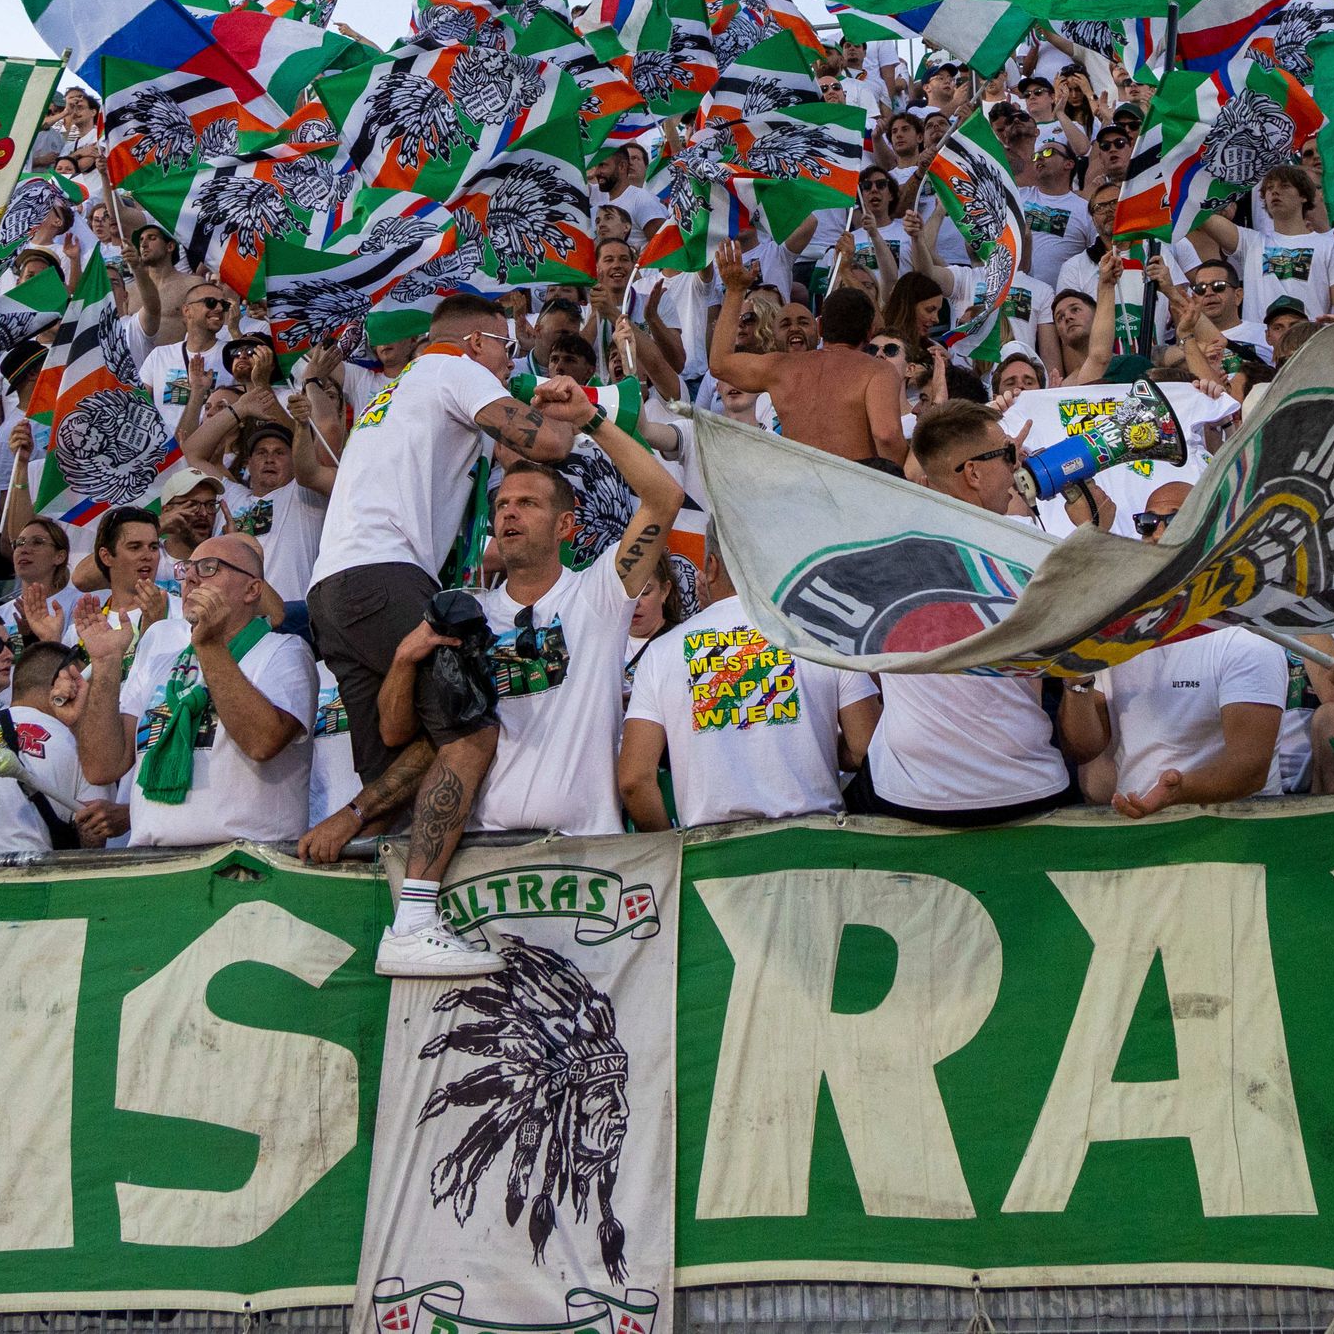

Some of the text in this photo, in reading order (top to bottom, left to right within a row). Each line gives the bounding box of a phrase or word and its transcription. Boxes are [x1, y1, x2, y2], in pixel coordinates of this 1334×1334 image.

[1062, 401, 1124, 417] VENE
[687, 629, 764, 650] VENEZ
[689, 649, 793, 676] MESTRE
[692, 675, 794, 701] RAPID
[694, 701, 797, 728] WIEN
[441, 874, 609, 926] ULTRAS
